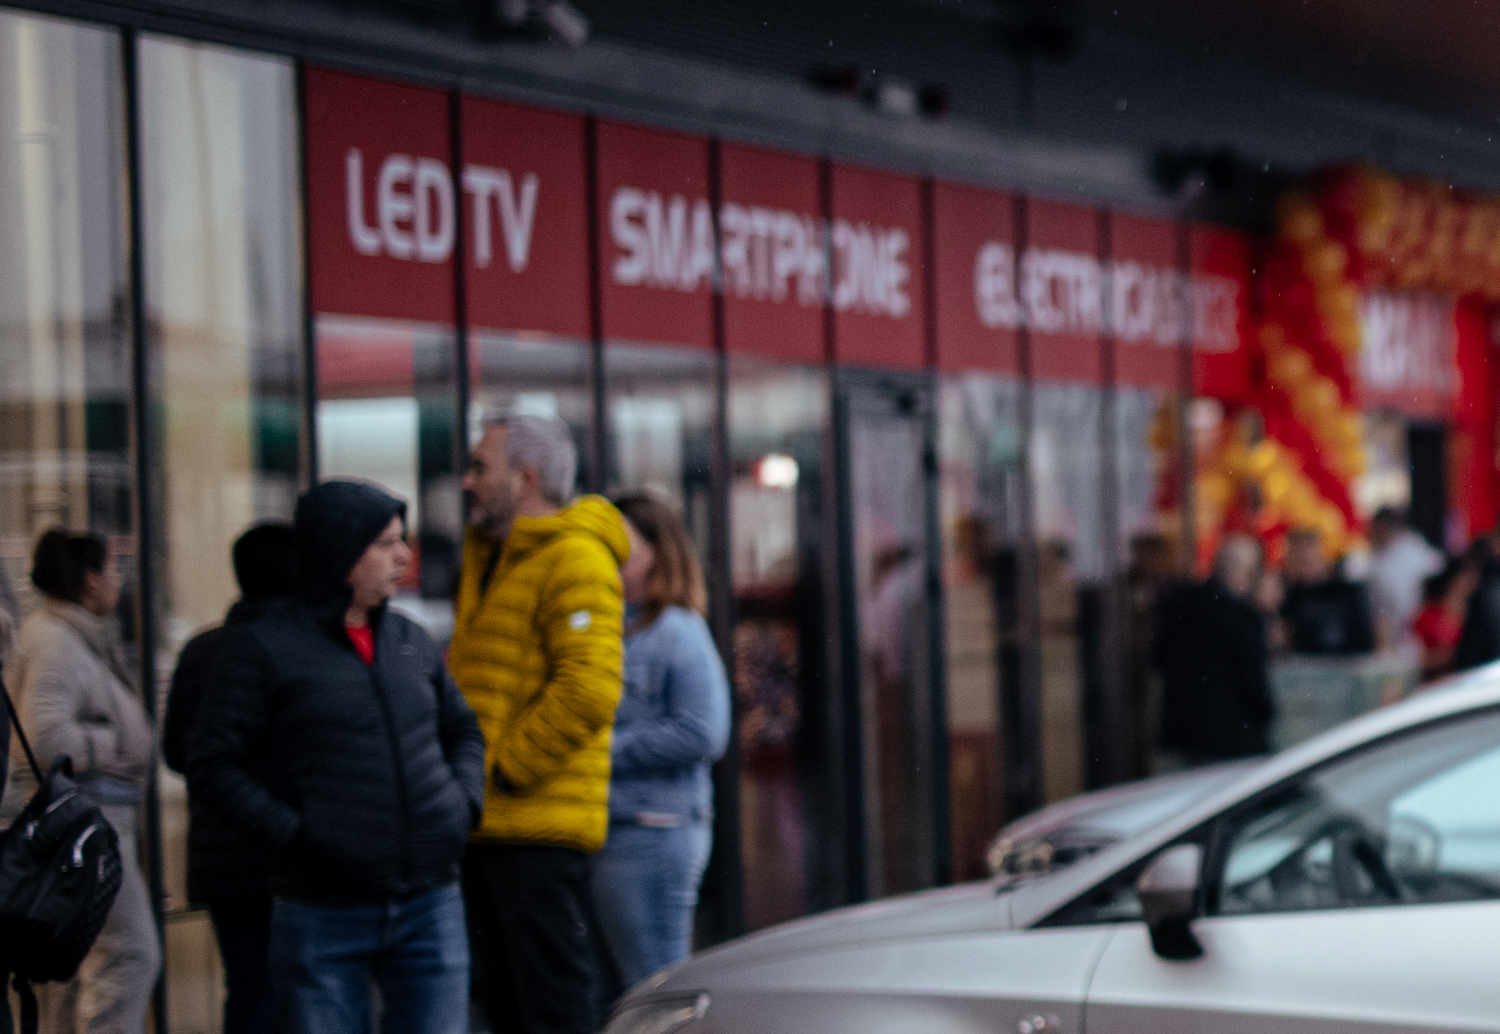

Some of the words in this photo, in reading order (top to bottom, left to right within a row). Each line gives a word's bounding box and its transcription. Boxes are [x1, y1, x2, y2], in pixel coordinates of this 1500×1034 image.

[345, 147, 457, 264] LED
[461, 163, 539, 273] TV
[609, 186, 912, 320] SMARTPHONE
